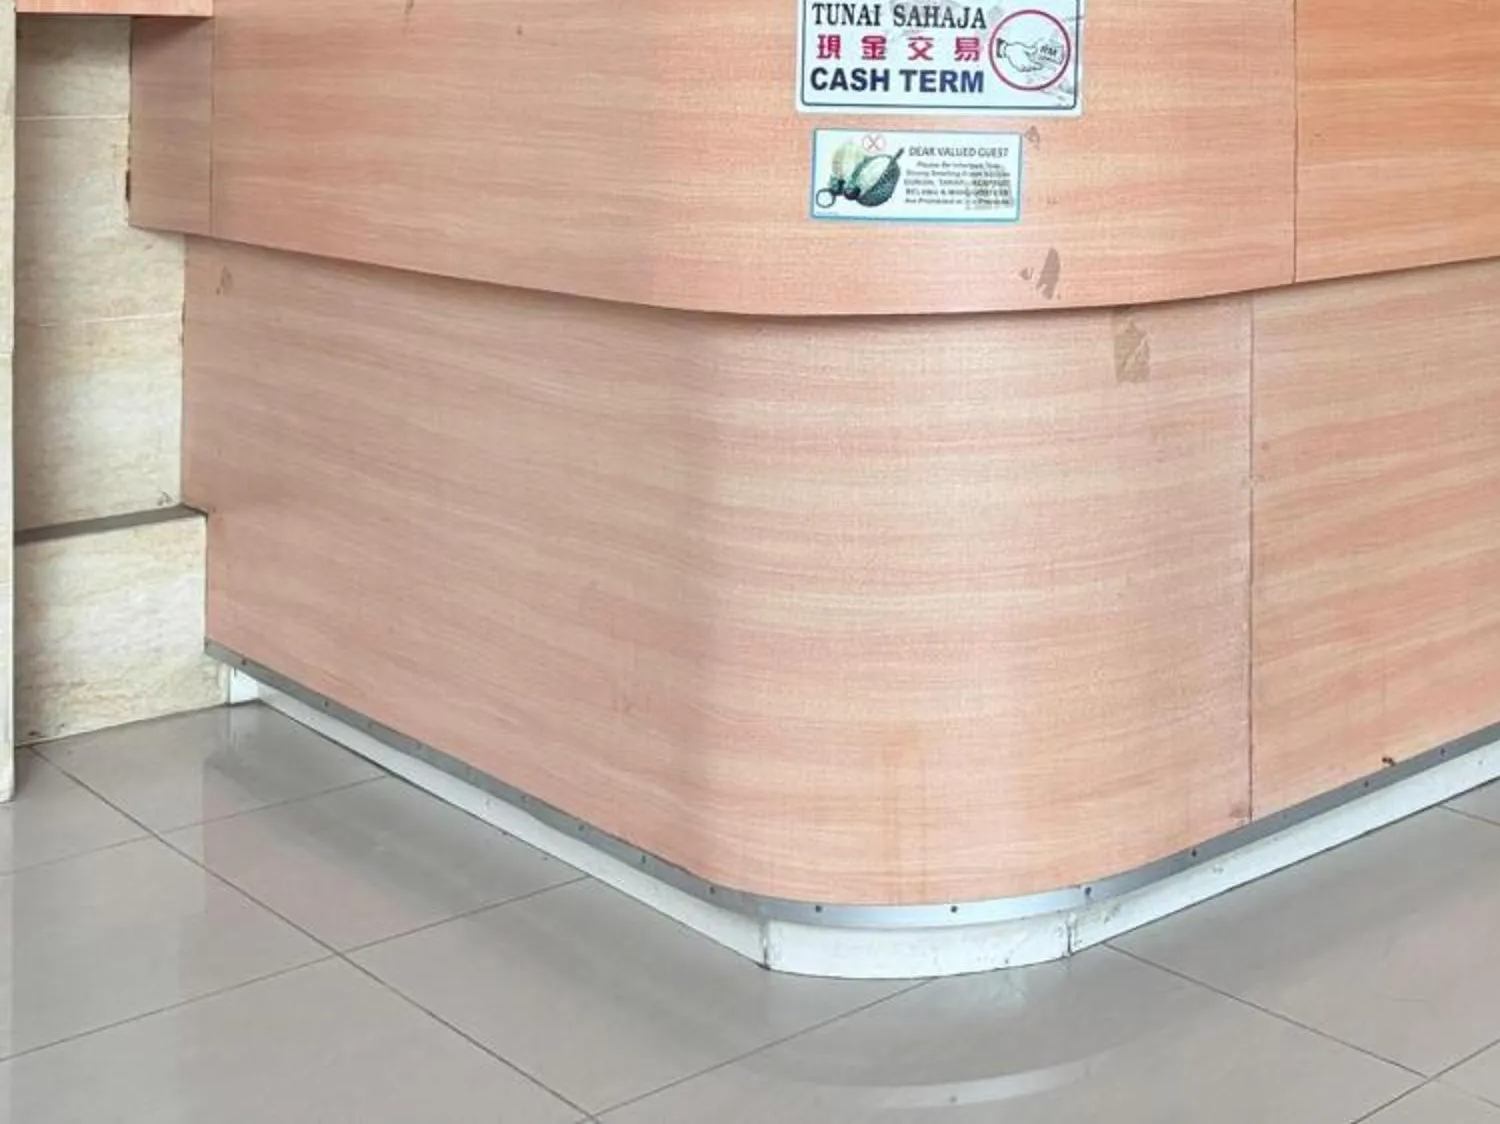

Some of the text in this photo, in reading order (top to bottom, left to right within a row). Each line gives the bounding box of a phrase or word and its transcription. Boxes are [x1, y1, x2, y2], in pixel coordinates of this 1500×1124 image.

[812, 3, 987, 29] TUNAI SAHAJA
[816, 33, 981, 62] 現金交易
[810, 67, 984, 93] CASH TERM
[908, 146, 1009, 158] DEAR VALUED GUEST
